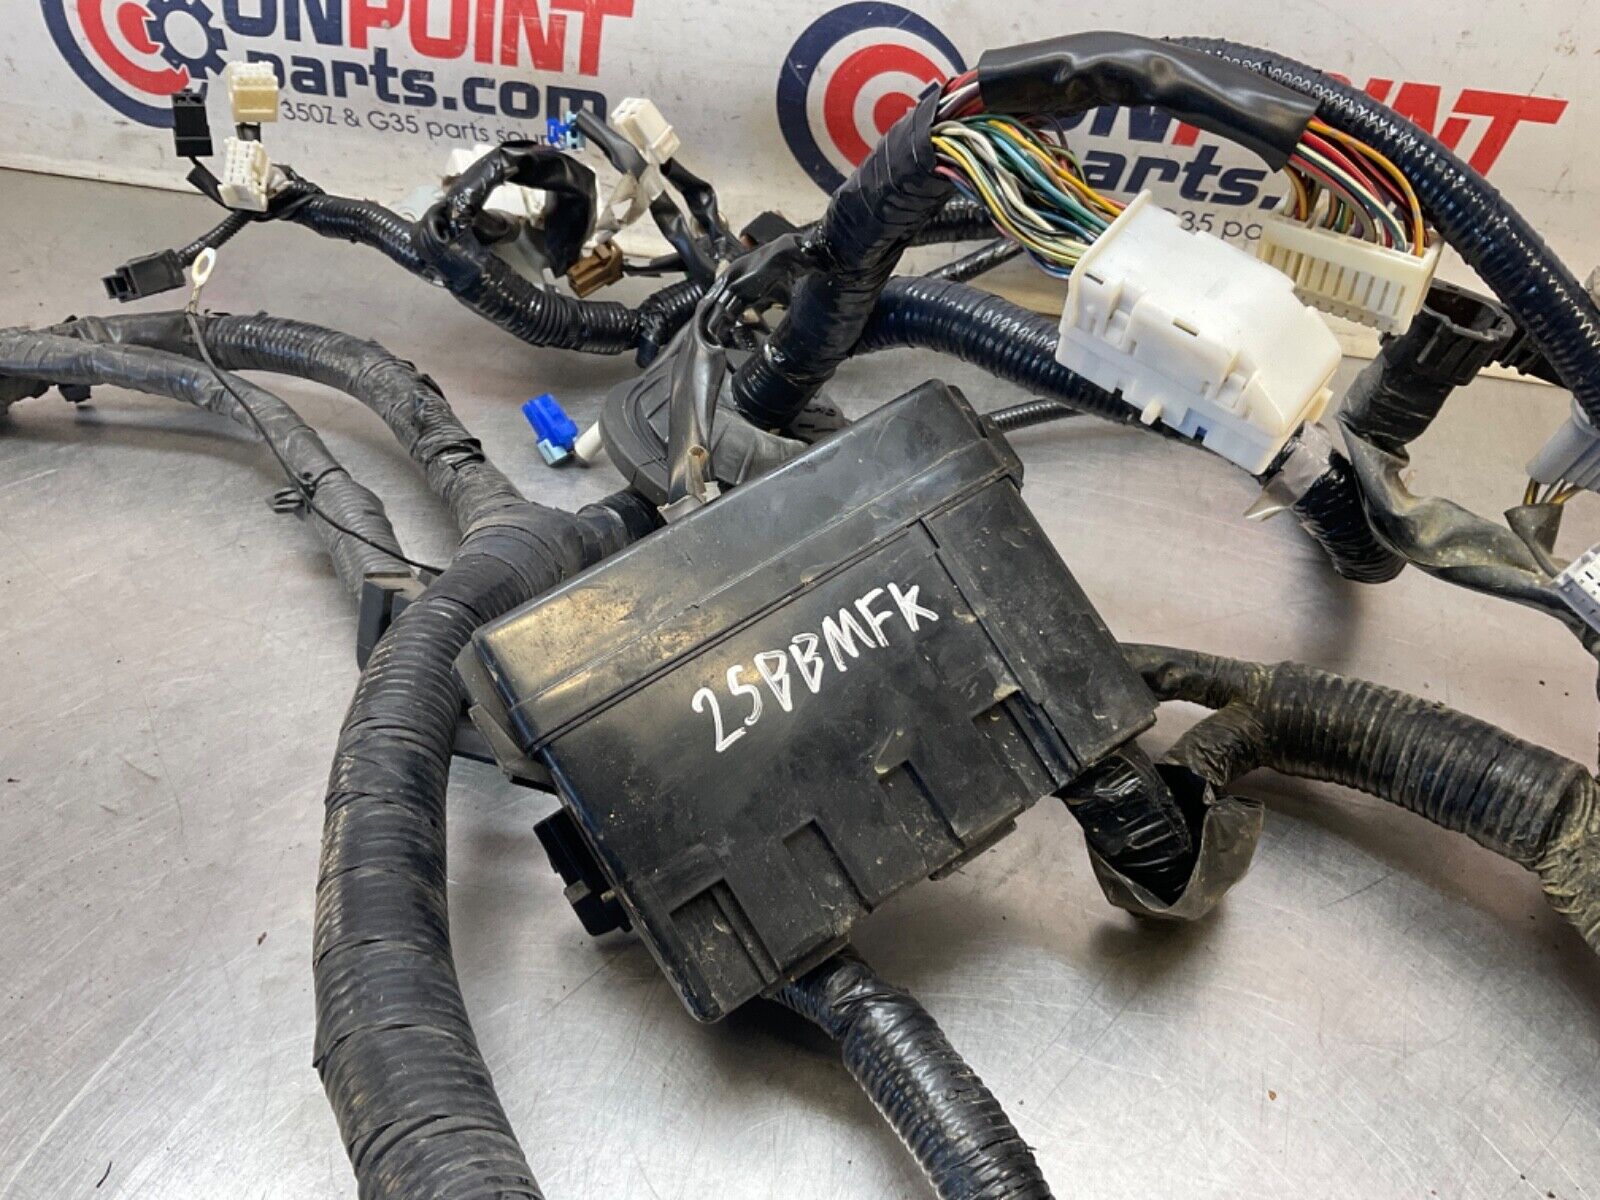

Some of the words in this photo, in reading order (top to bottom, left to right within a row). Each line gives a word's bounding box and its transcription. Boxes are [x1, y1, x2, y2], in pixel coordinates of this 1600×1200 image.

[281, 100, 338, 125] 350Z
[343, 109, 362, 128] &
[367, 110, 420, 134] G35
[426, 120, 490, 143] parts
[1163, 202, 1215, 233] 35
